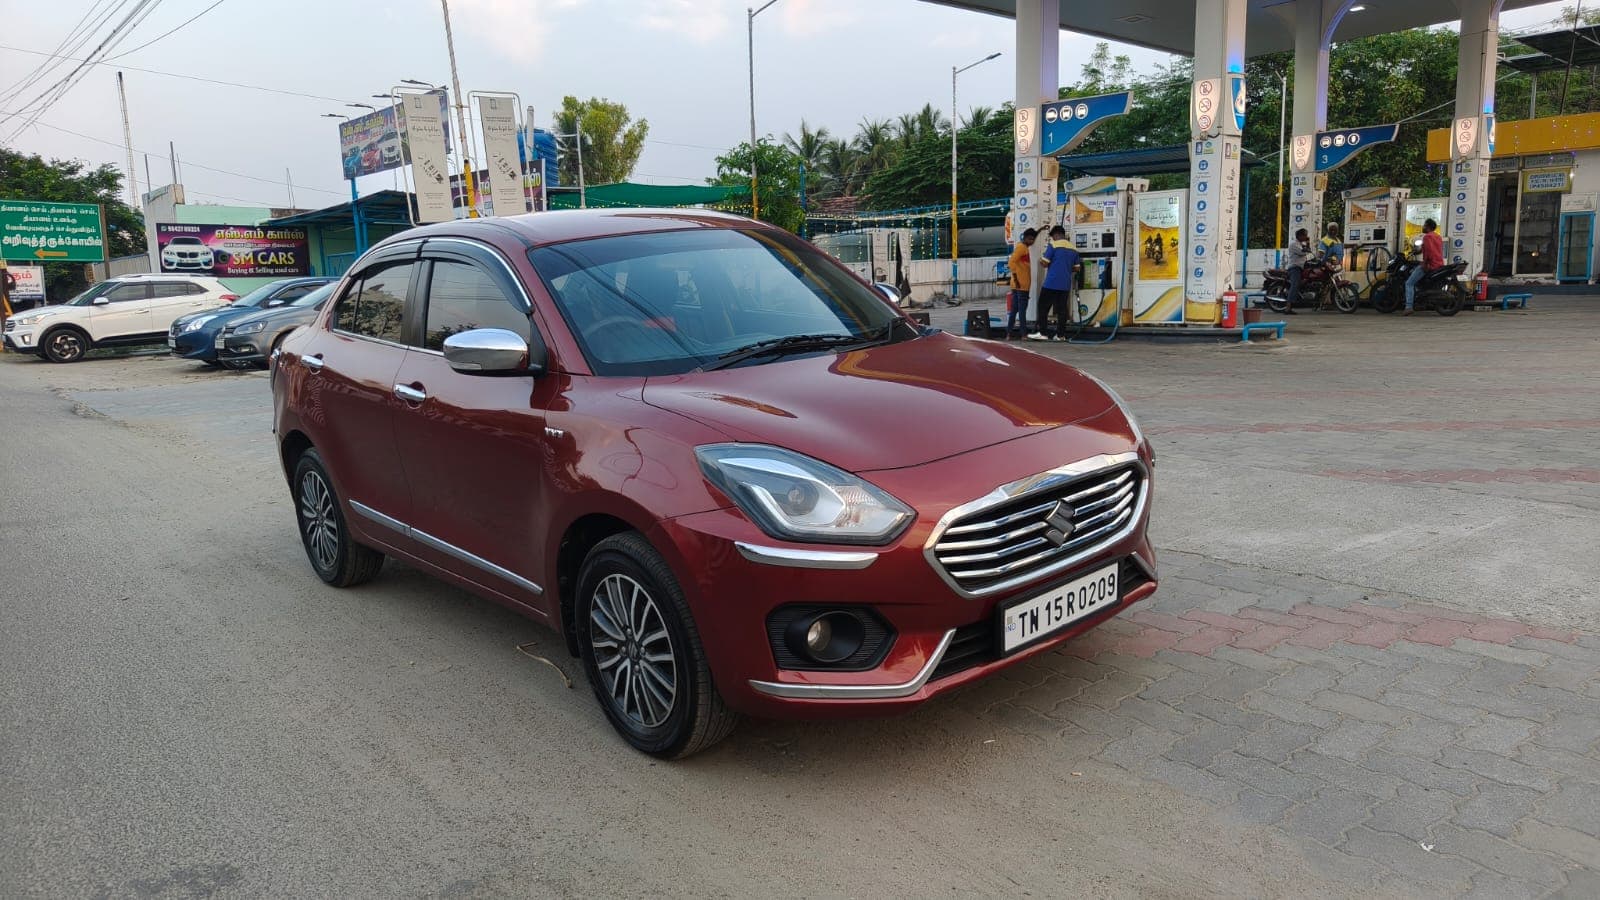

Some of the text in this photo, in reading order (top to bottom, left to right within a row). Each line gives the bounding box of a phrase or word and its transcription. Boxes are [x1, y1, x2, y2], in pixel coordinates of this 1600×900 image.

[1048, 132, 1053, 144] 1
[1321, 155, 1328, 164] 3
[232, 252, 295, 265] SM CARS
[227, 267, 248, 275] Buying
[1018, 606, 1039, 638] TN
[1045, 596, 1063, 626] 15
[1078, 573, 1116, 610] 0209
